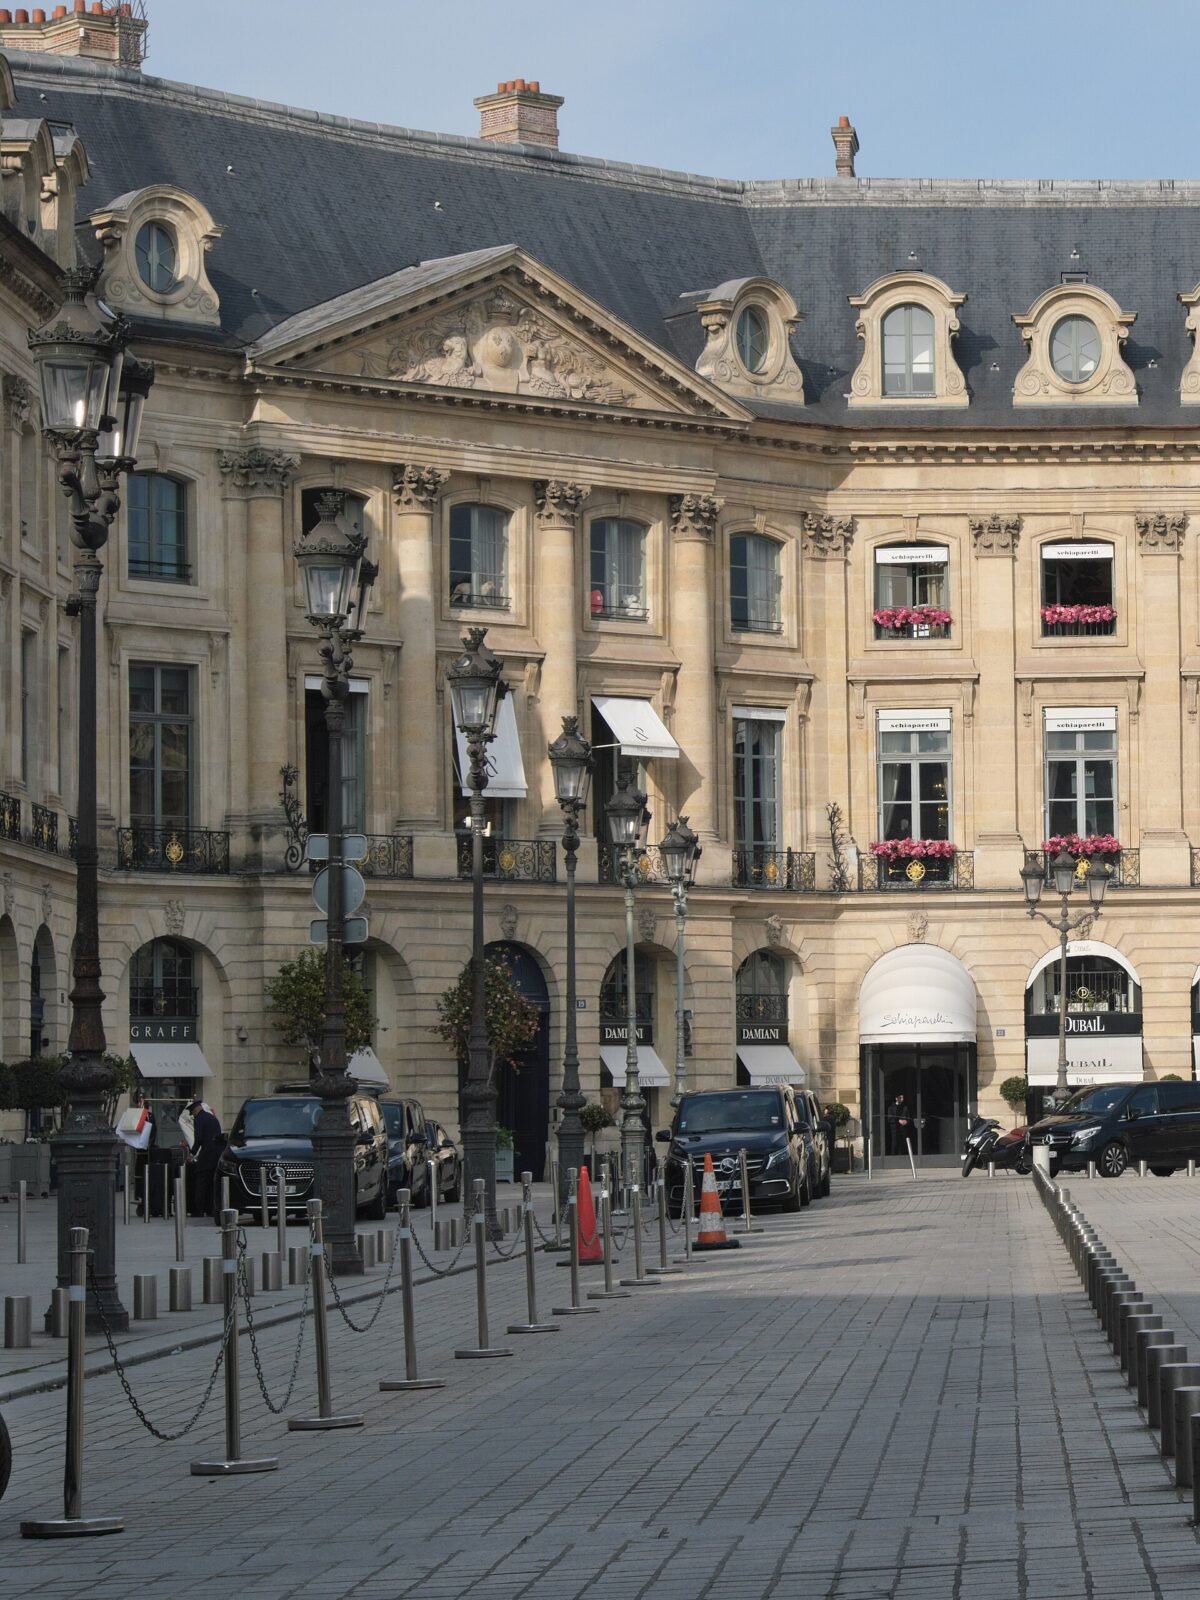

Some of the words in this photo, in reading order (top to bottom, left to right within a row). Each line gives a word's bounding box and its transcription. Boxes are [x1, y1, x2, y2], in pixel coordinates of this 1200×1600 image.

[891, 553, 933, 561] schiaparelli
[890, 722, 939, 730] schiaparelli
[1056, 722, 1105, 730] schiaparelli
[1064, 1016, 1106, 1032] DUBAIL
[131, 1026, 190, 1038] GRAFF
[605, 1027, 643, 1039] DAMINI
[742, 1028, 780, 1039] DAMIANI
